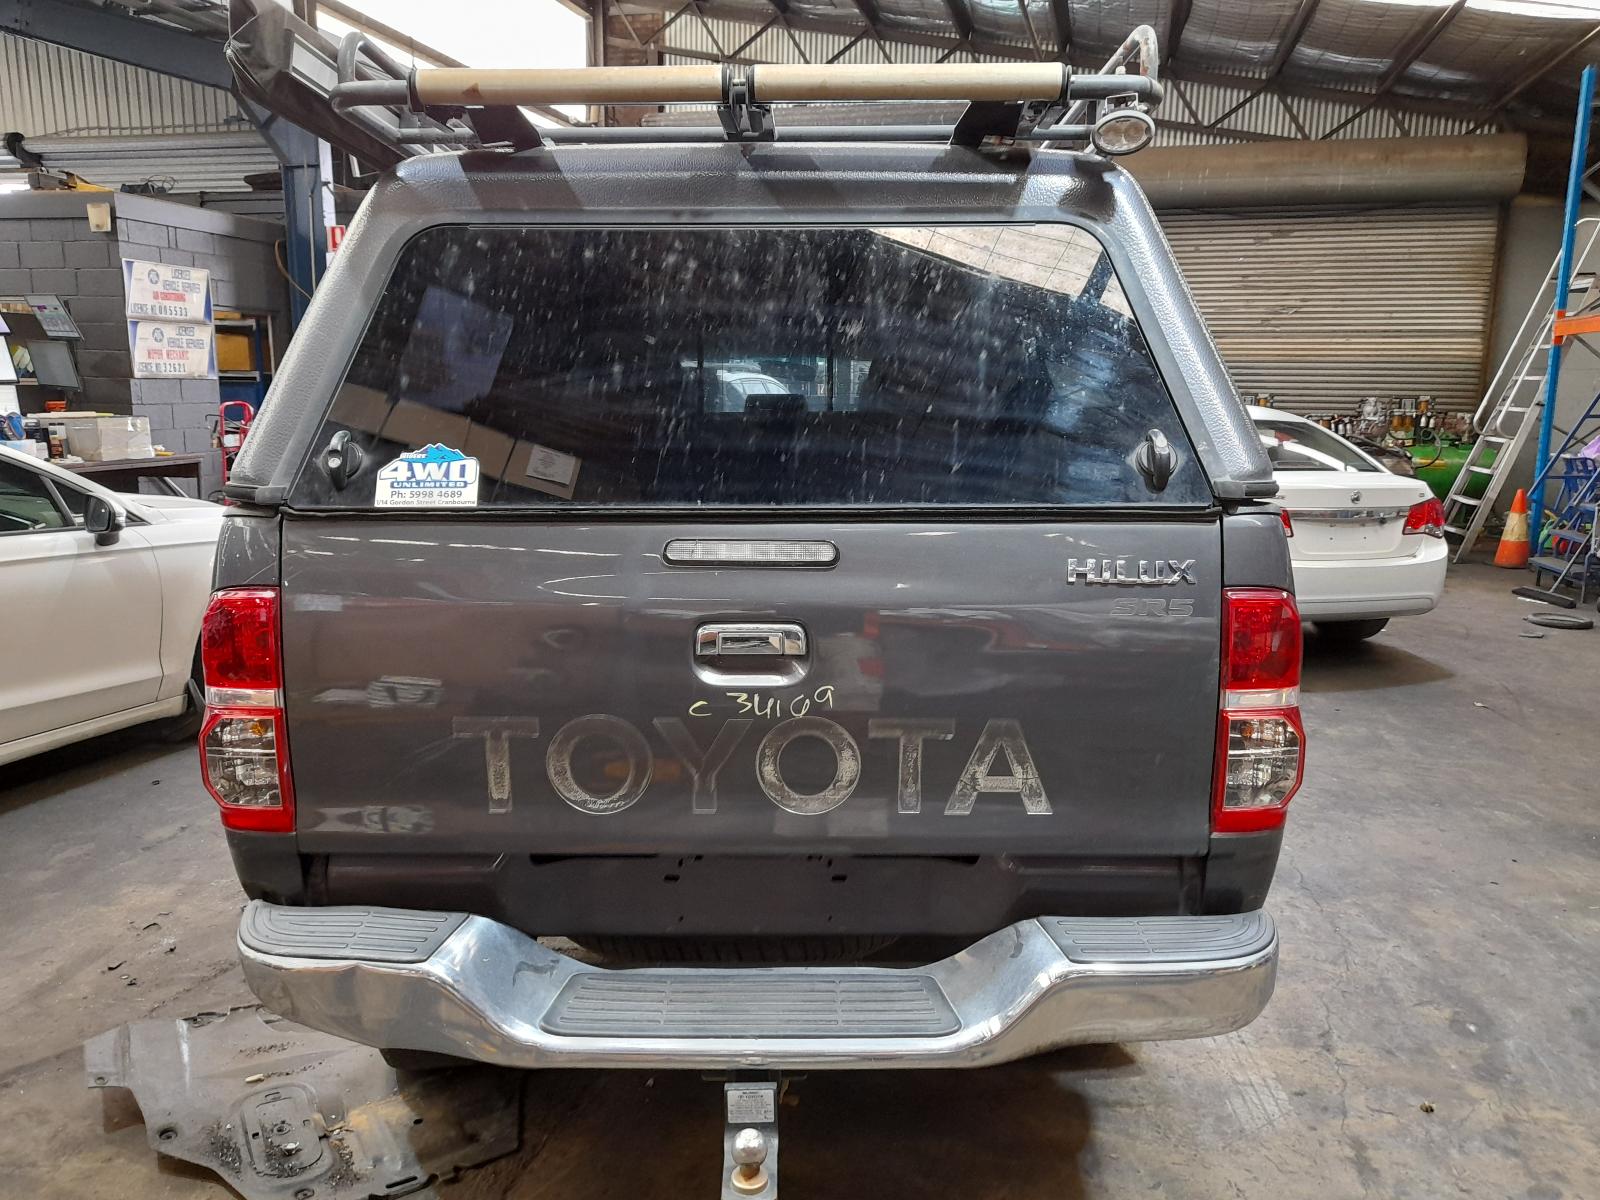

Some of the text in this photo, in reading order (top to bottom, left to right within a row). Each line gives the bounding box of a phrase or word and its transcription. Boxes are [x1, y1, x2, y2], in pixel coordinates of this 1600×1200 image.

[379, 458, 477, 484] 4WD
[390, 490, 463, 499] Ph: 5998 4689
[1066, 558, 1198, 586] HILUX
[1110, 597, 1196, 617] SR5
[452, 713, 1054, 816] TOYOTA
